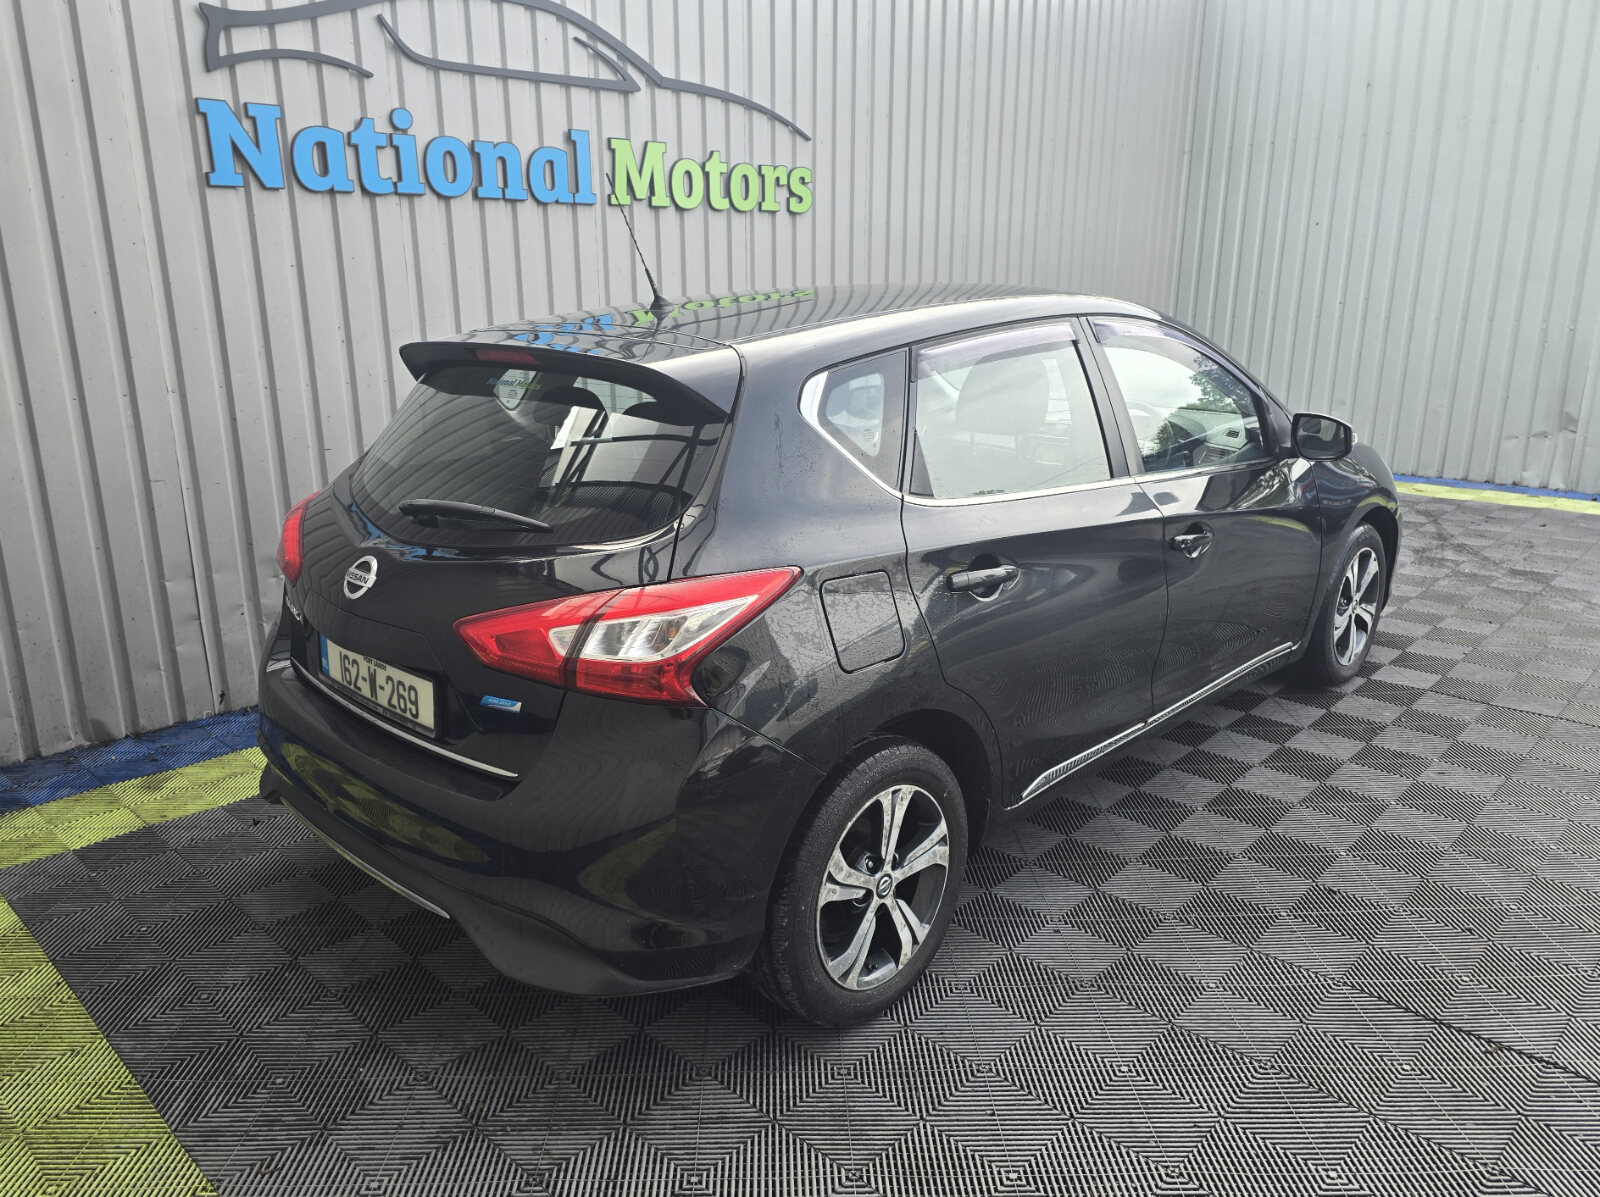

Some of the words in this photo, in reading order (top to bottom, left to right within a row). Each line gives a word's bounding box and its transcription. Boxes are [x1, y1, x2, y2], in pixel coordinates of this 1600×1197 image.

[196, 97, 597, 206] National
[608, 137, 814, 214] Motors
[346, 569, 370, 584] NISSAN
[339, 651, 419, 719] 162-W-269
